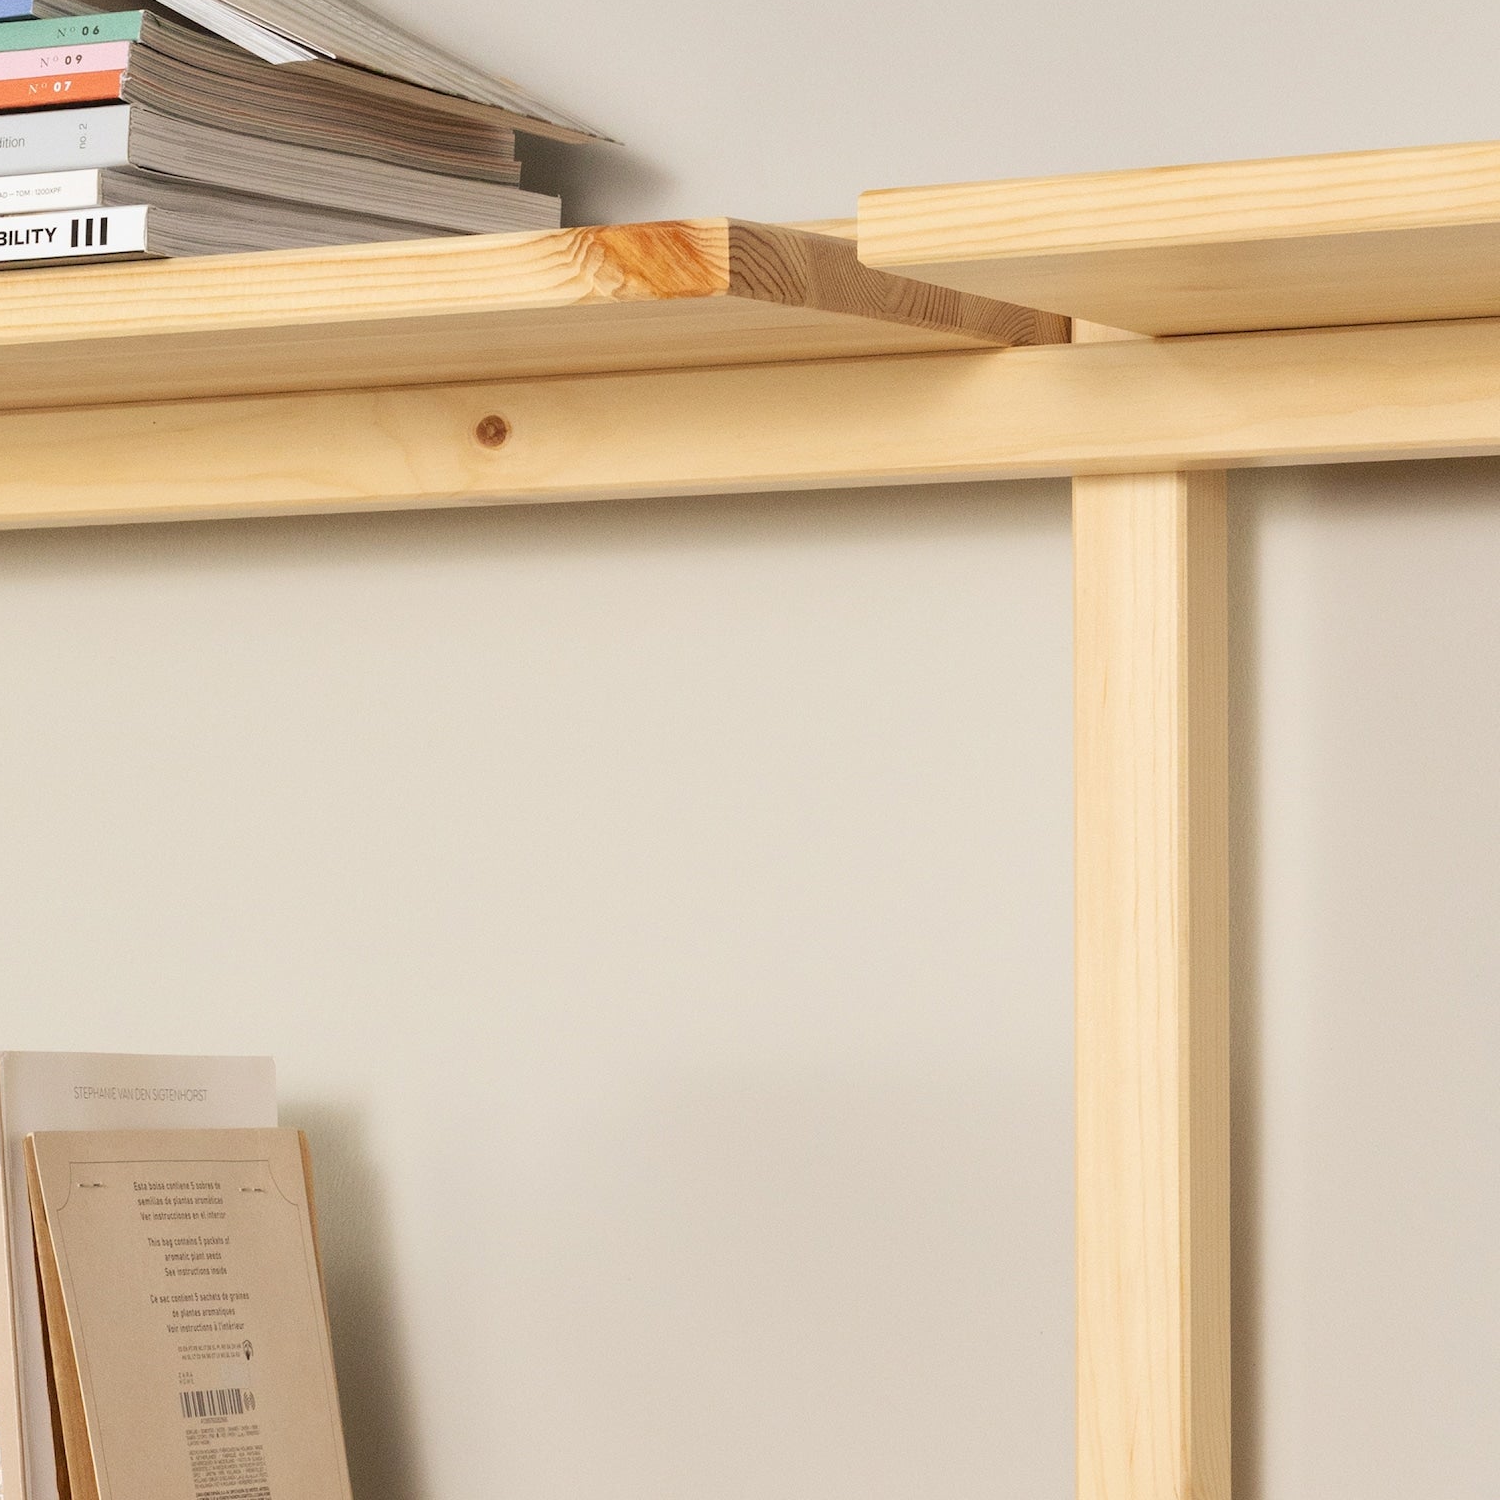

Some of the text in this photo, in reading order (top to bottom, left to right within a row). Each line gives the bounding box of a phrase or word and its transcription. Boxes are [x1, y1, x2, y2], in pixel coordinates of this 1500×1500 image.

[81, 25, 100, 36] 06
[64, 54, 83, 65] 09
[53, 80, 72, 92] 07
[79, 122, 88, 131] 2
[73, 1086, 116, 1100] STEPHANIE
[117, 1087, 134, 1100] VAN
[133, 1182, 148, 1191] Esta
[191, 1181, 195, 1190] 5
[153, 1212, 192, 1220] instrucciones
[165, 1252, 190, 1261] aromatic
[177, 1267, 210, 1276] instructions
[195, 1293, 199, 1301] 5
